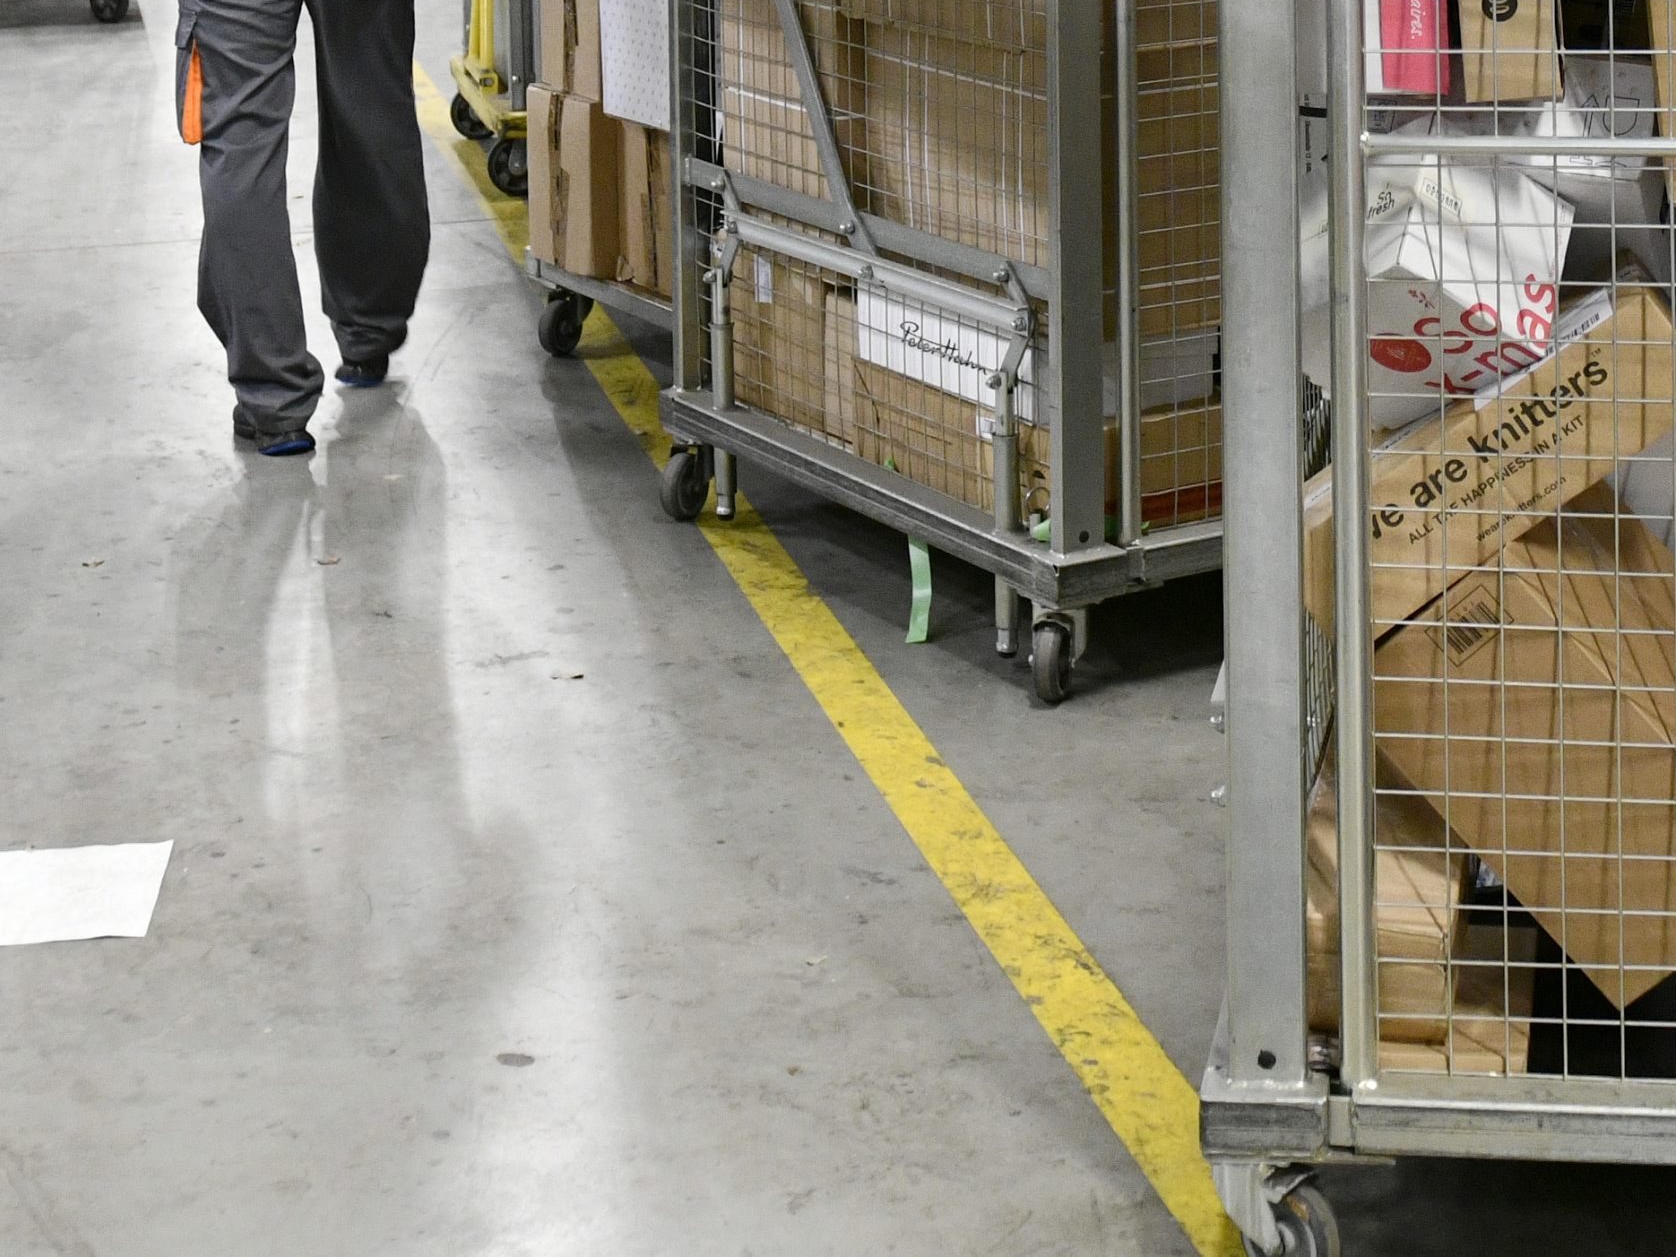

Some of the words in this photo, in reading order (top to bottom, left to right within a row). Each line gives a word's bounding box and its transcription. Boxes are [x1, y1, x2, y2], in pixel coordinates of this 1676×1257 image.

[1367, 198, 1395, 219] fresh
[900, 320, 942, 356] Peter
[940, 337, 988, 376] Hahn
[1413, 302, 1503, 355] So
[1407, 526, 1434, 545] ALL
[1463, 450, 1534, 506] HAPPINESS
[1533, 439, 1550, 456] IN
[1561, 414, 1585, 437] KIT
[1409, 458, 1468, 509] are
